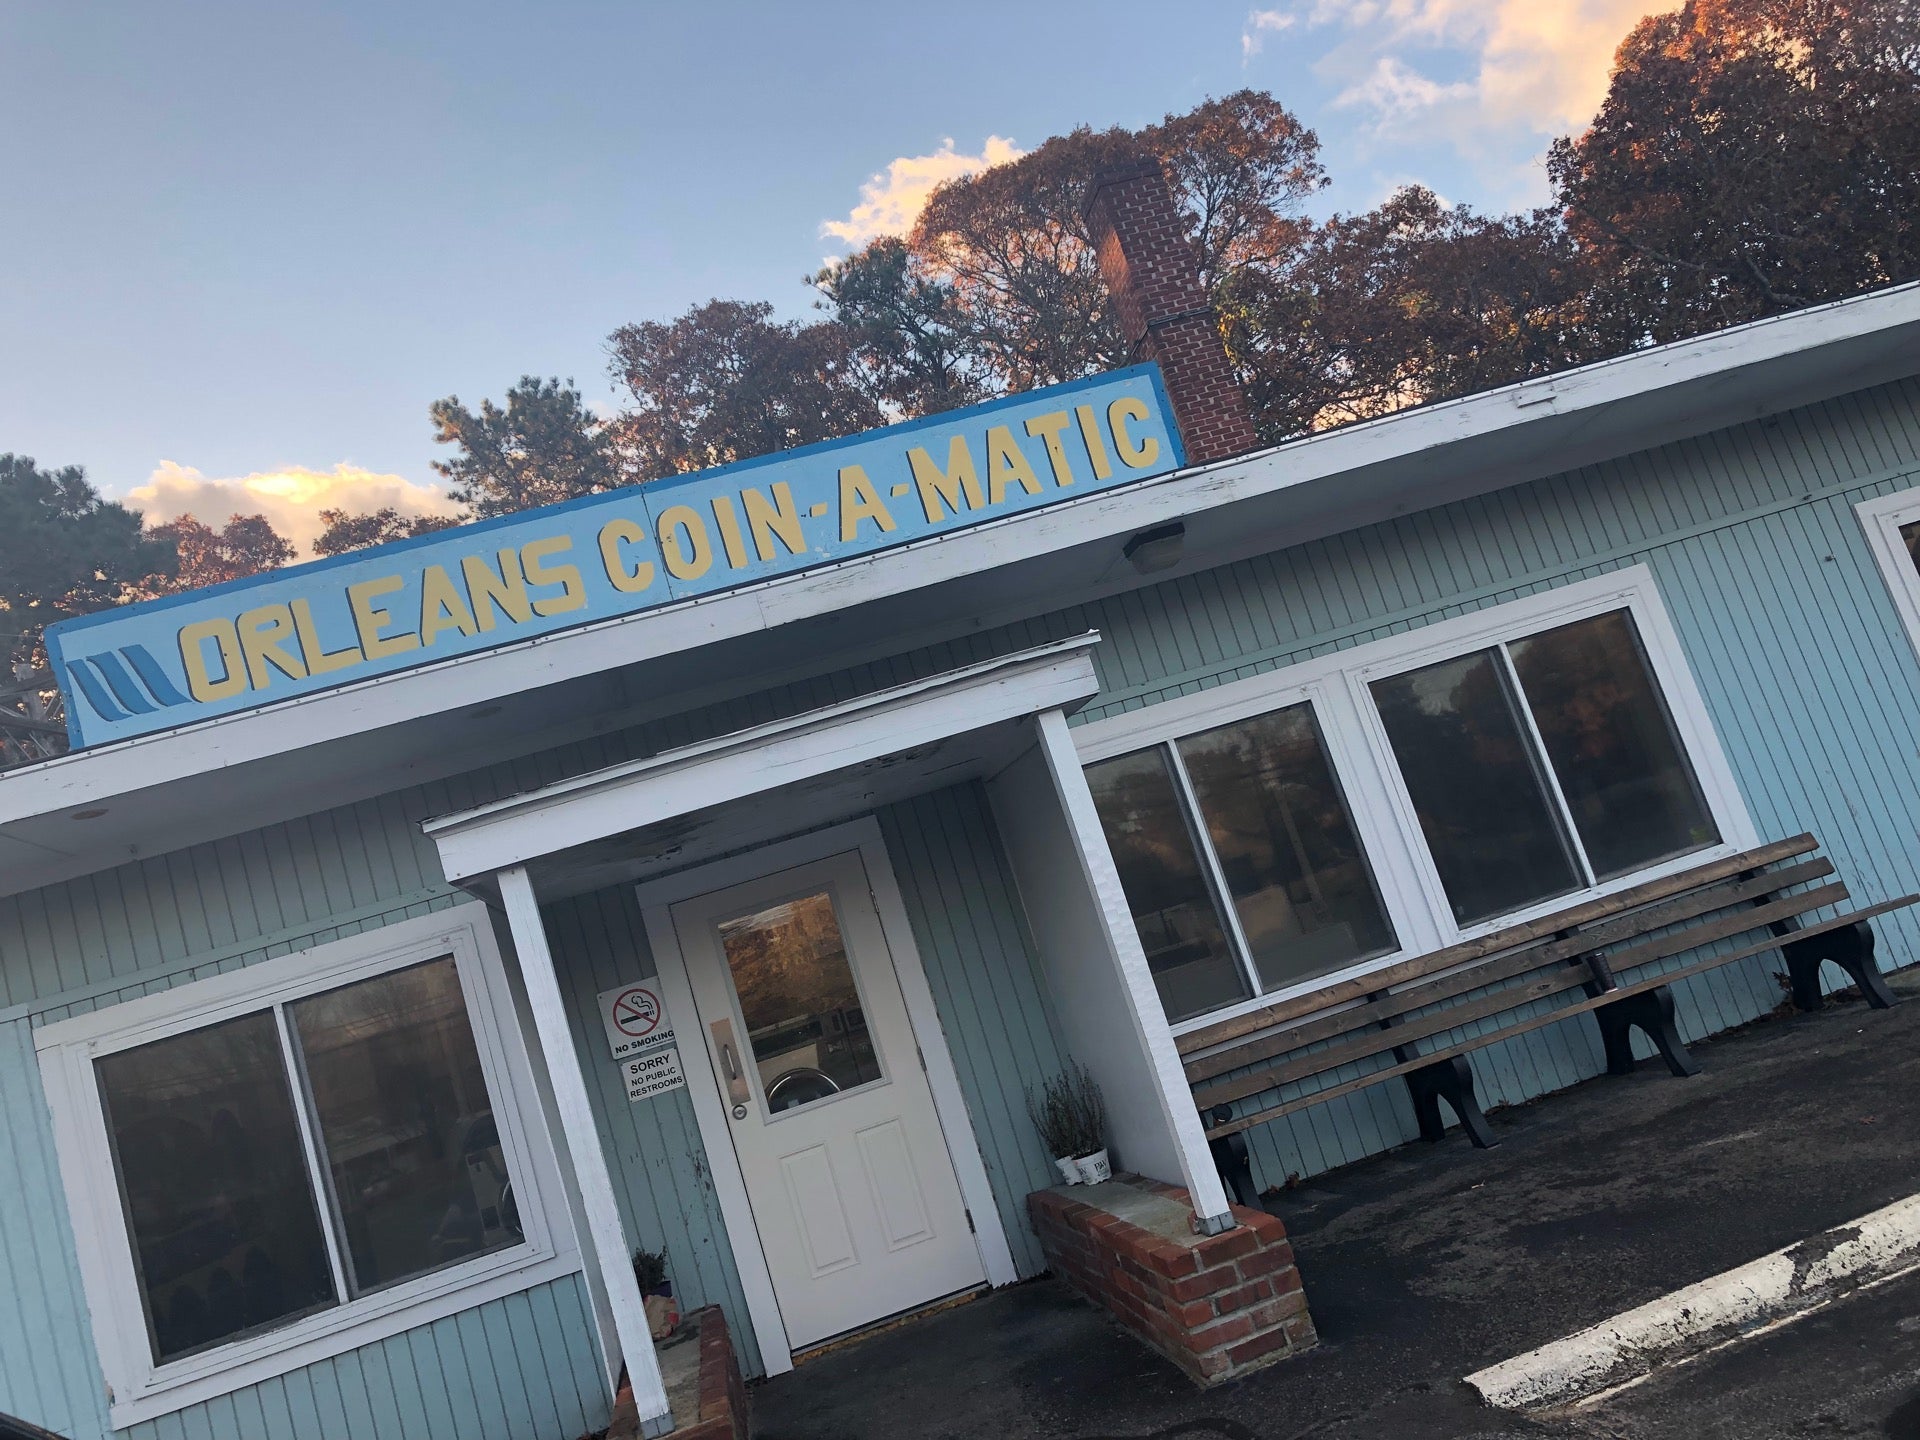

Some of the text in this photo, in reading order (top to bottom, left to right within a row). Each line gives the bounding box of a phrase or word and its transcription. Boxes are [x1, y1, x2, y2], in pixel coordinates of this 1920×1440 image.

[177, 397, 1159, 703] ORLEANS COIN-A-MATIC
[615, 1044, 629, 1054] NO
[631, 1030, 675, 1049] SMOKING
[630, 1054, 670, 1074] SORRY
[630, 1075, 683, 1098] RESTROOMS
[631, 1066, 676, 1086] NO PUBLIC
